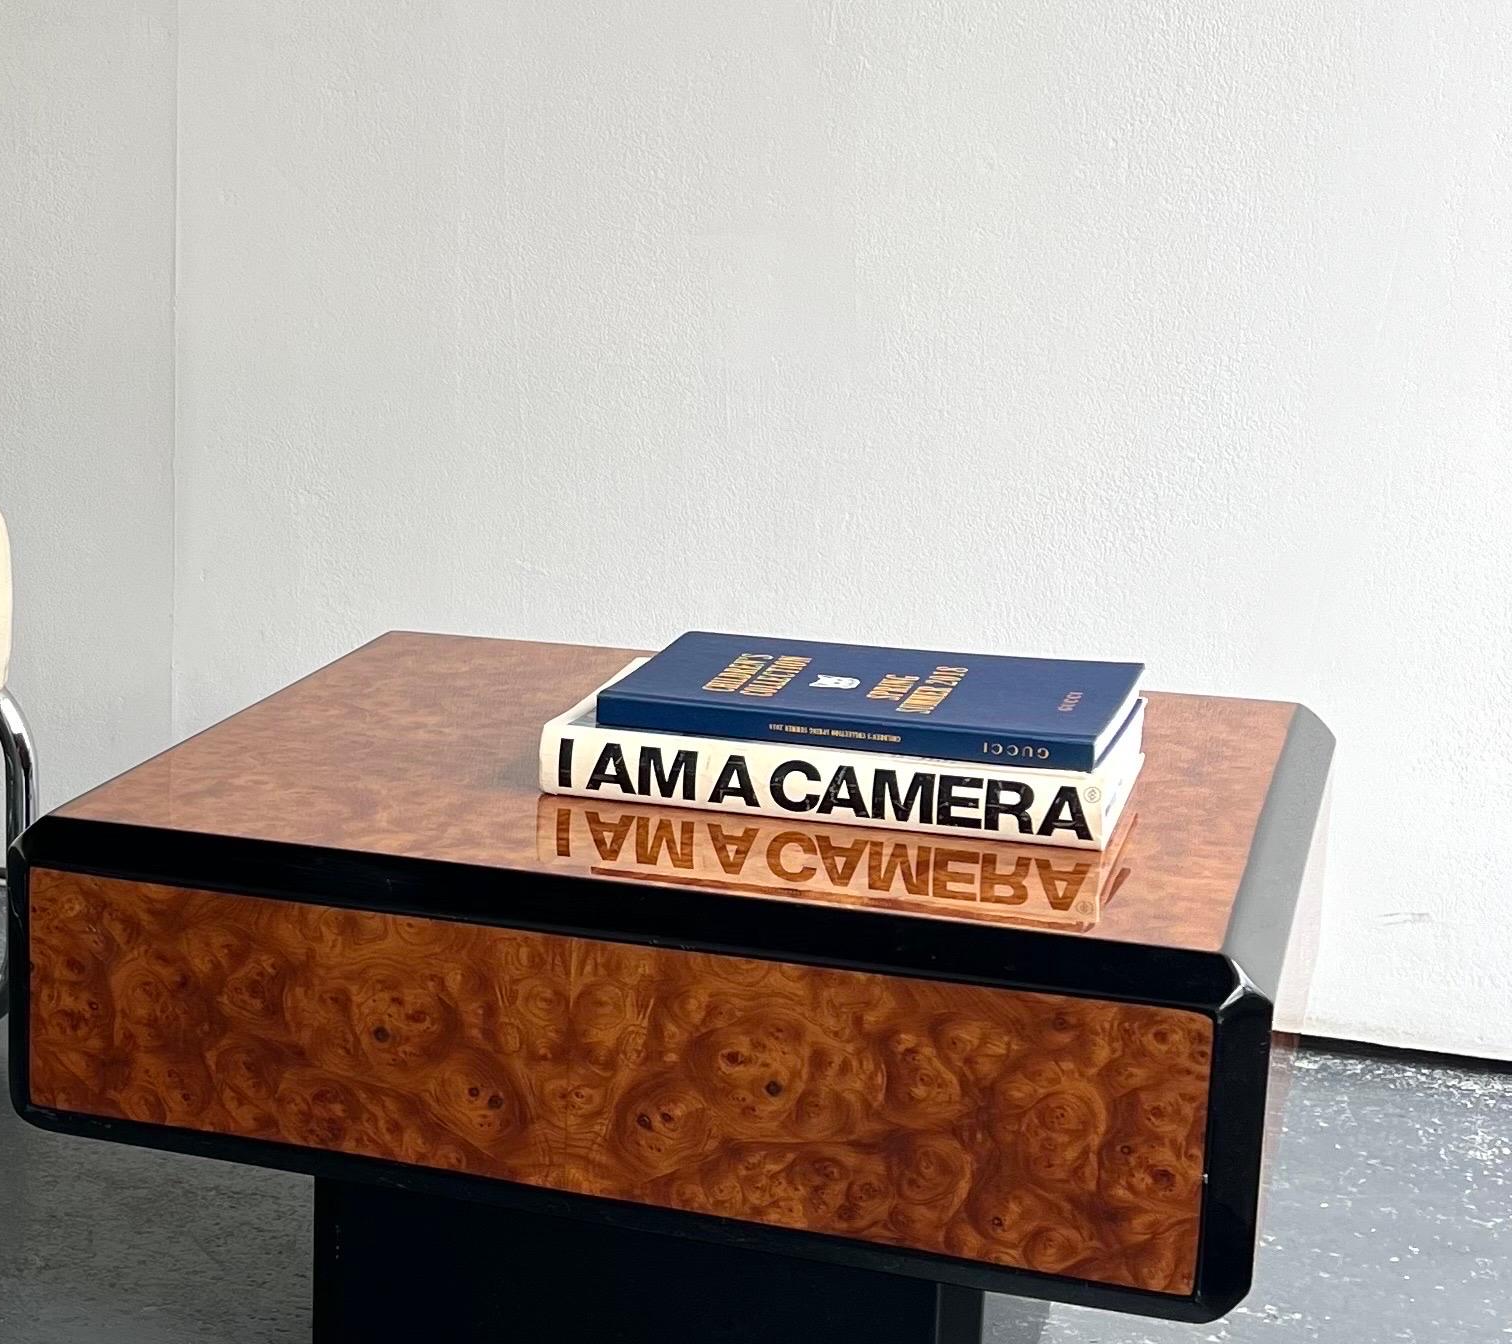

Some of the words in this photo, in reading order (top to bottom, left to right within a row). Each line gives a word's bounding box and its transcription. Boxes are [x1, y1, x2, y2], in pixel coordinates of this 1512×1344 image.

[701, 653, 774, 692] CHILDREN'S
[739, 655, 813, 697] COLLECTION
[866, 674, 920, 701] SPRING
[895, 686, 953, 714] SUMMER
[925, 666, 969, 687] 2018
[1057, 691, 1083, 711] GUCCI
[983, 742, 1050, 759] GUCCI
[558, 738, 575, 788] I
[585, 742, 699, 801] AM
[707, 754, 761, 808] A
[769, 759, 1094, 841] CAMERA
